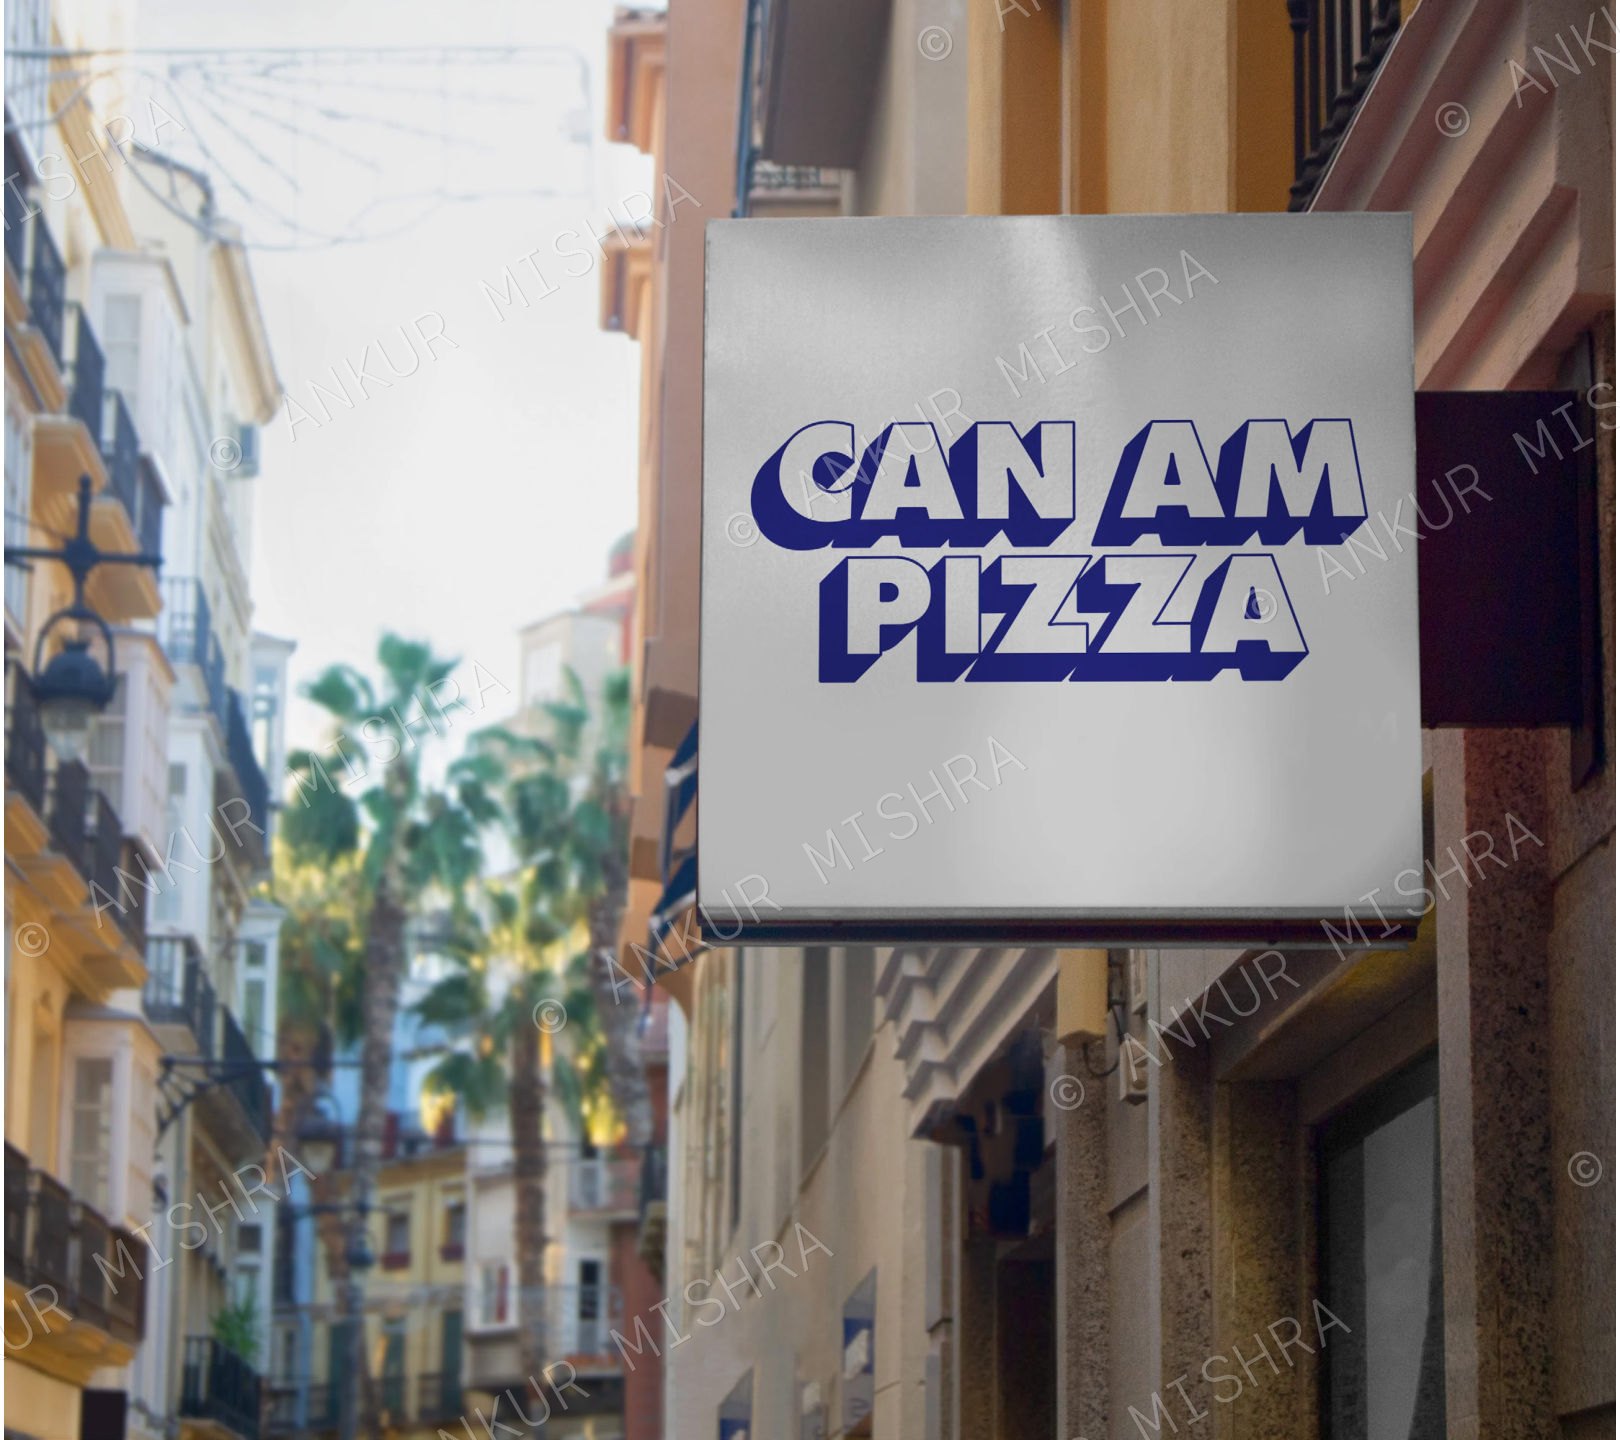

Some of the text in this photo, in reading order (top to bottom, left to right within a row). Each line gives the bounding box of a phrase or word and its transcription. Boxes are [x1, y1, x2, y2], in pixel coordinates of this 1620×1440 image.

[751, 418, 1368, 550] CAN AM
[819, 554, 1310, 683] PIZZA
